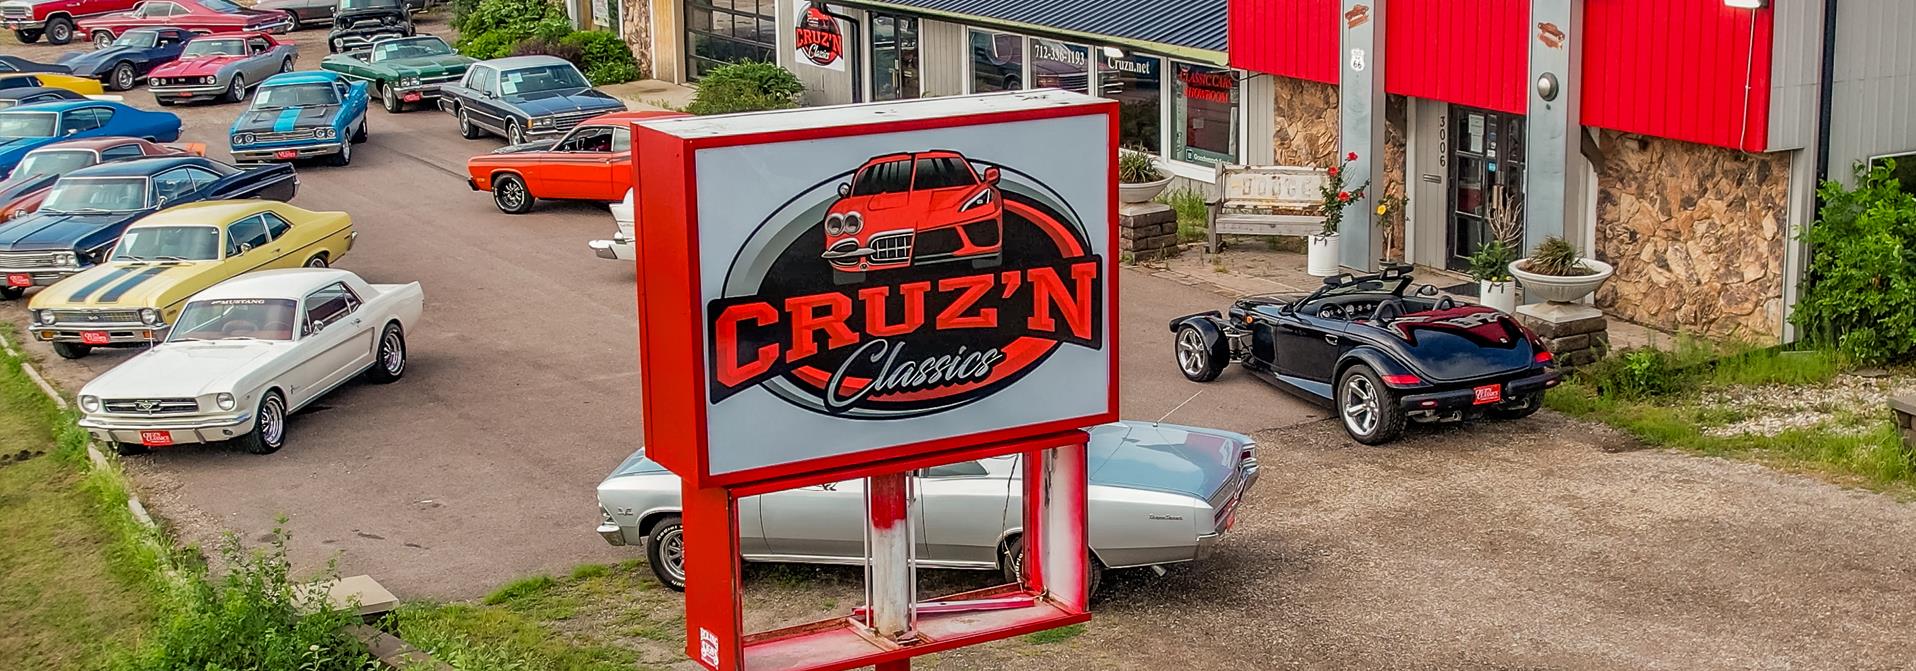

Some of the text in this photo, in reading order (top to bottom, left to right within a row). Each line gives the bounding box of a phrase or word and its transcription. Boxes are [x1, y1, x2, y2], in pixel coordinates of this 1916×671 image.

[796, 28, 842, 57] CRUZ'N
[1107, 56, 1150, 74] Cruzn.net
[715, 261, 1097, 389] CRUZ'N
[827, 338, 1003, 408] Classics
